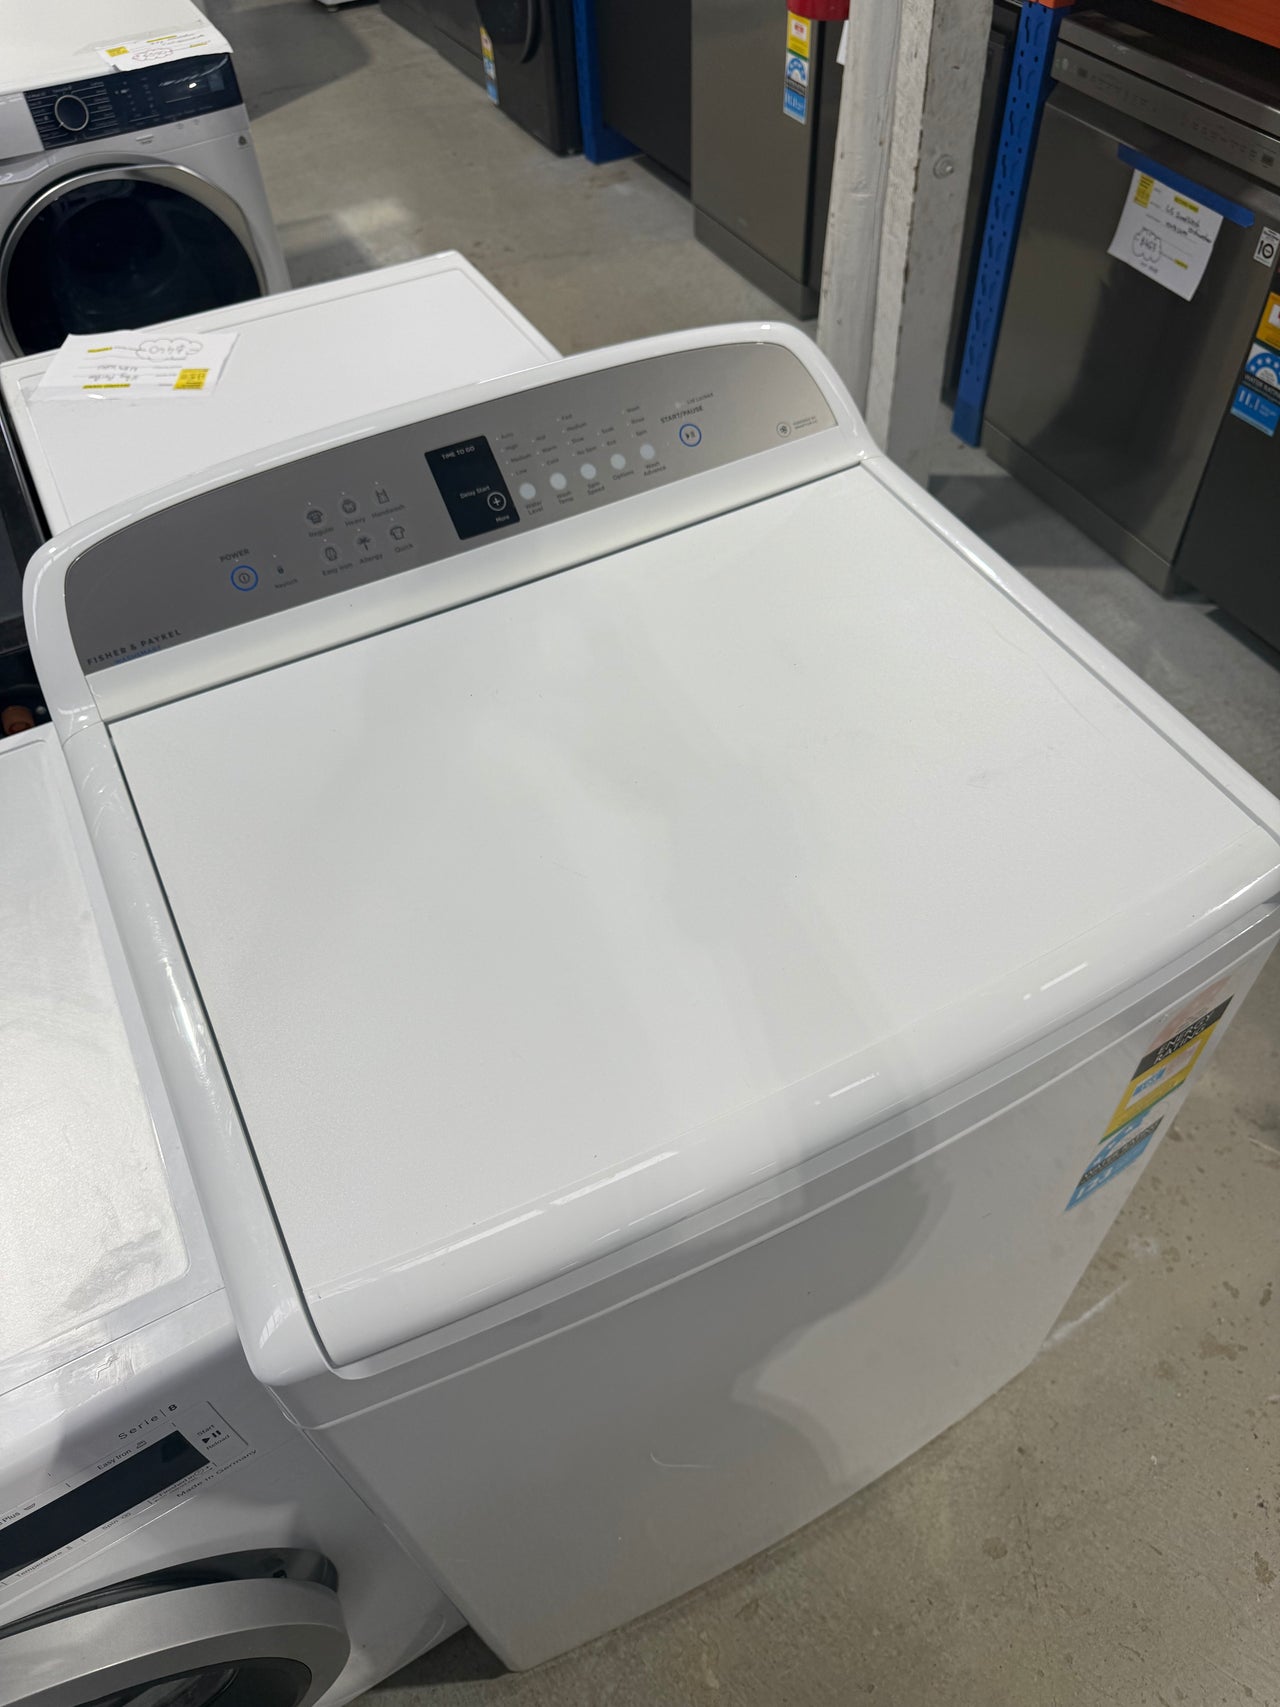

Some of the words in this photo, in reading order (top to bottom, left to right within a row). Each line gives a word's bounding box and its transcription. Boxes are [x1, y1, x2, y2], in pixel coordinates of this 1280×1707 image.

[660, 405, 704, 424] START/PAUSE
[441, 452, 456, 460] TIME
[612, 469, 635, 481] Options
[476, 485, 491, 494] Start
[345, 517, 366, 527] Heavy
[495, 515, 510, 523] More
[394, 543, 414, 553] Quick
[219, 548, 250, 563] POWER
[359, 553, 383, 565] Allergy
[87, 647, 126, 666] FISHER
[129, 643, 137, 651] &
[140, 629, 182, 647] PAYKEL
[118, 1414, 159, 1441] Serie
[168, 1403, 178, 1412] 8
[196, 1424, 215, 1437] Start
[206, 1434, 230, 1451] Reload
[97, 1459, 116, 1471] Easy
[116, 1448, 132, 1461] Iron
[176, 1482, 203, 1498] Made
[216, 1449, 257, 1475] Germany
[2, 1511, 21, 1524] Plus
[102, 1519, 119, 1531] Spin
[15, 1551, 63, 1577] Temperature
